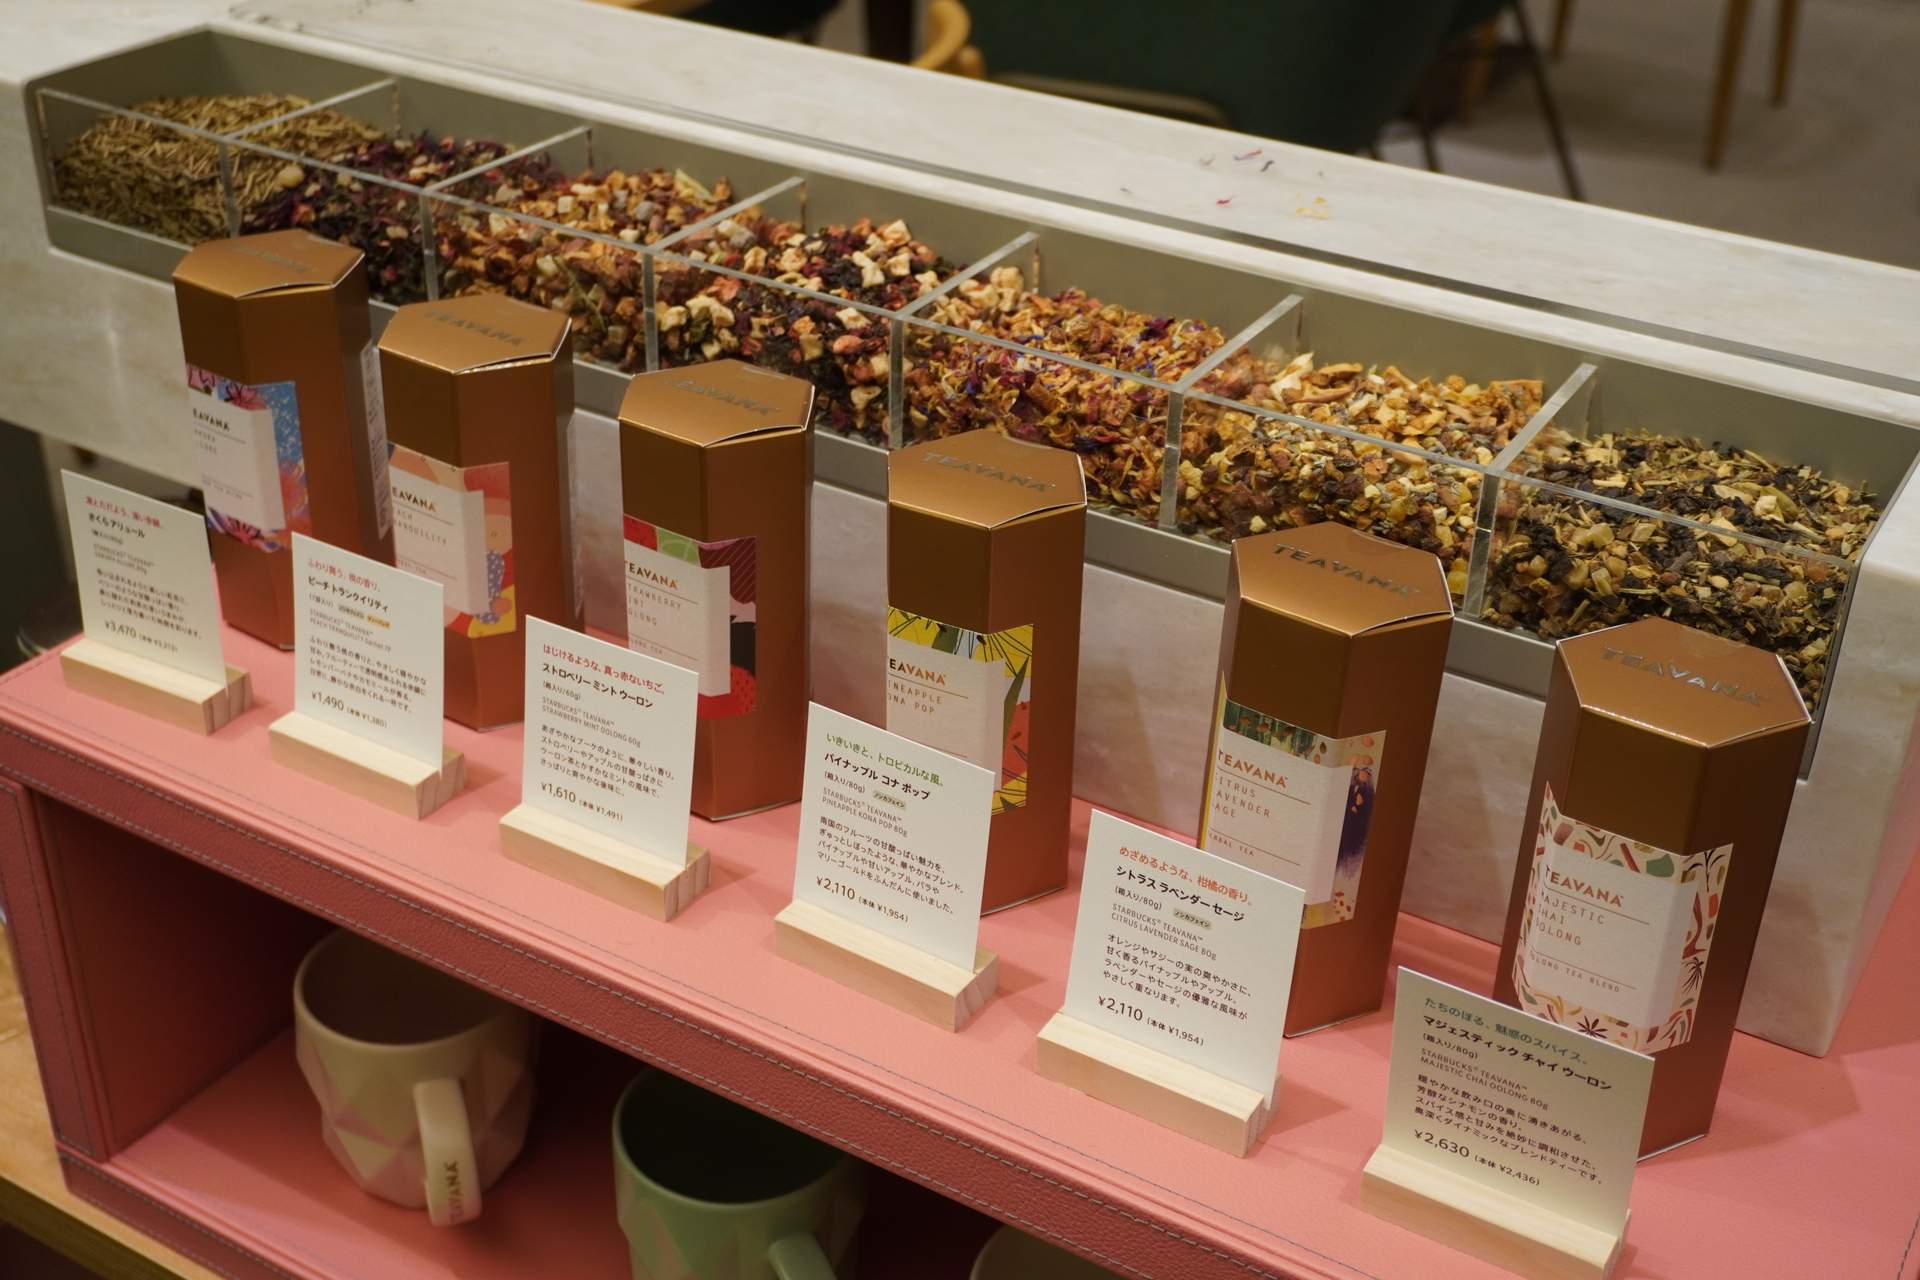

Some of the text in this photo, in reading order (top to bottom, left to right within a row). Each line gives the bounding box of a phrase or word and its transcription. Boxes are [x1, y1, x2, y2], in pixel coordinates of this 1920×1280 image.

[424, 309, 524, 347] TEAVANA
[661, 376, 772, 416] TEAVANA
[923, 452, 1046, 493] TEAVANA
[392, 486, 436, 513] EAVANA
[394, 508, 412, 521] ACH
[1274, 543, 1410, 597] TEAVANA
[308, 575, 388, 613] ピーチ トランクイリティ
[104, 620, 137, 638] ¥3,470
[310, 617, 328, 628] PEACH
[328, 624, 364, 642] TRANQUILITY
[365, 638, 383, 650] Sachet
[630, 637, 647, 648] LONG
[543, 644, 665, 695] はじけるような、真っ赤ないちご。
[543, 663, 653, 708] ストロベリー ミント ウーロン
[888, 656, 946, 686] EAVANA
[1602, 646, 1761, 707] TEAVANA
[311, 691, 344, 711] ¥1,490
[914, 701, 935, 714] POP
[542, 705, 641, 748] STRAWBERRY MINT OOLONG 60g
[824, 753, 931, 800] パイナップル コナ ポップ
[827, 733, 943, 787] いきいきと、トロピカルな風。
[541, 782, 576, 803] ¥1,610
[596, 805, 623, 822] ¥1,491)
[824, 771, 905, 808] (箱入り/80g) ノンカフェイン
[1215, 786, 1270, 818] AVENDER
[1216, 771, 1256, 798] ITRUS
[822, 796, 908, 838] PINEAPPLE KONA POP 80g
[1213, 799, 1236, 818] AGE
[1208, 831, 1254, 857] ERBAL TEA
[1117, 866, 1244, 921] シトラス ラベンダー セージ
[1119, 846, 1251, 906] めざめるような、柑橘の香り。
[1546, 864, 1622, 908] TEAVANA
[817, 876, 855, 900] ¥2,110
[877, 904, 908, 923] ¥1,954)
[1115, 885, 1210, 927] (箱入り/80g) ノンカフェイン
[1111, 912, 1217, 961] CITRUS LAVENDER SAGE 80g
[1108, 934, 1251, 997] オレンジやサジーの実の爽やかさに、
[1566, 968, 1582, 979] TEA
[1590, 977, 1620, 993] BLEND
[1103, 970, 1180, 1008] やさしく重なります。
[1105, 958, 1247, 1020] ラベンダーやセージの優雅な風味が
[1099, 996, 1143, 1021] ¥2,110
[1169, 1025, 1204, 1046] ¥1,954)
[1425, 998, 1587, 1065] たちのぼる、魅惑のスパイス。
[1423, 1033, 1478, 1059] (箱入り/80g)
[1423, 1015, 1611, 1089] マジェスティック チャイ ウーロン
[1420, 1056, 1548, 1110] MAJESTIC CHAI OOLONG 80g
[1415, 1129, 1469, 1157] ¥2,630
[1499, 1164, 1540, 1186] ¥2,436)
